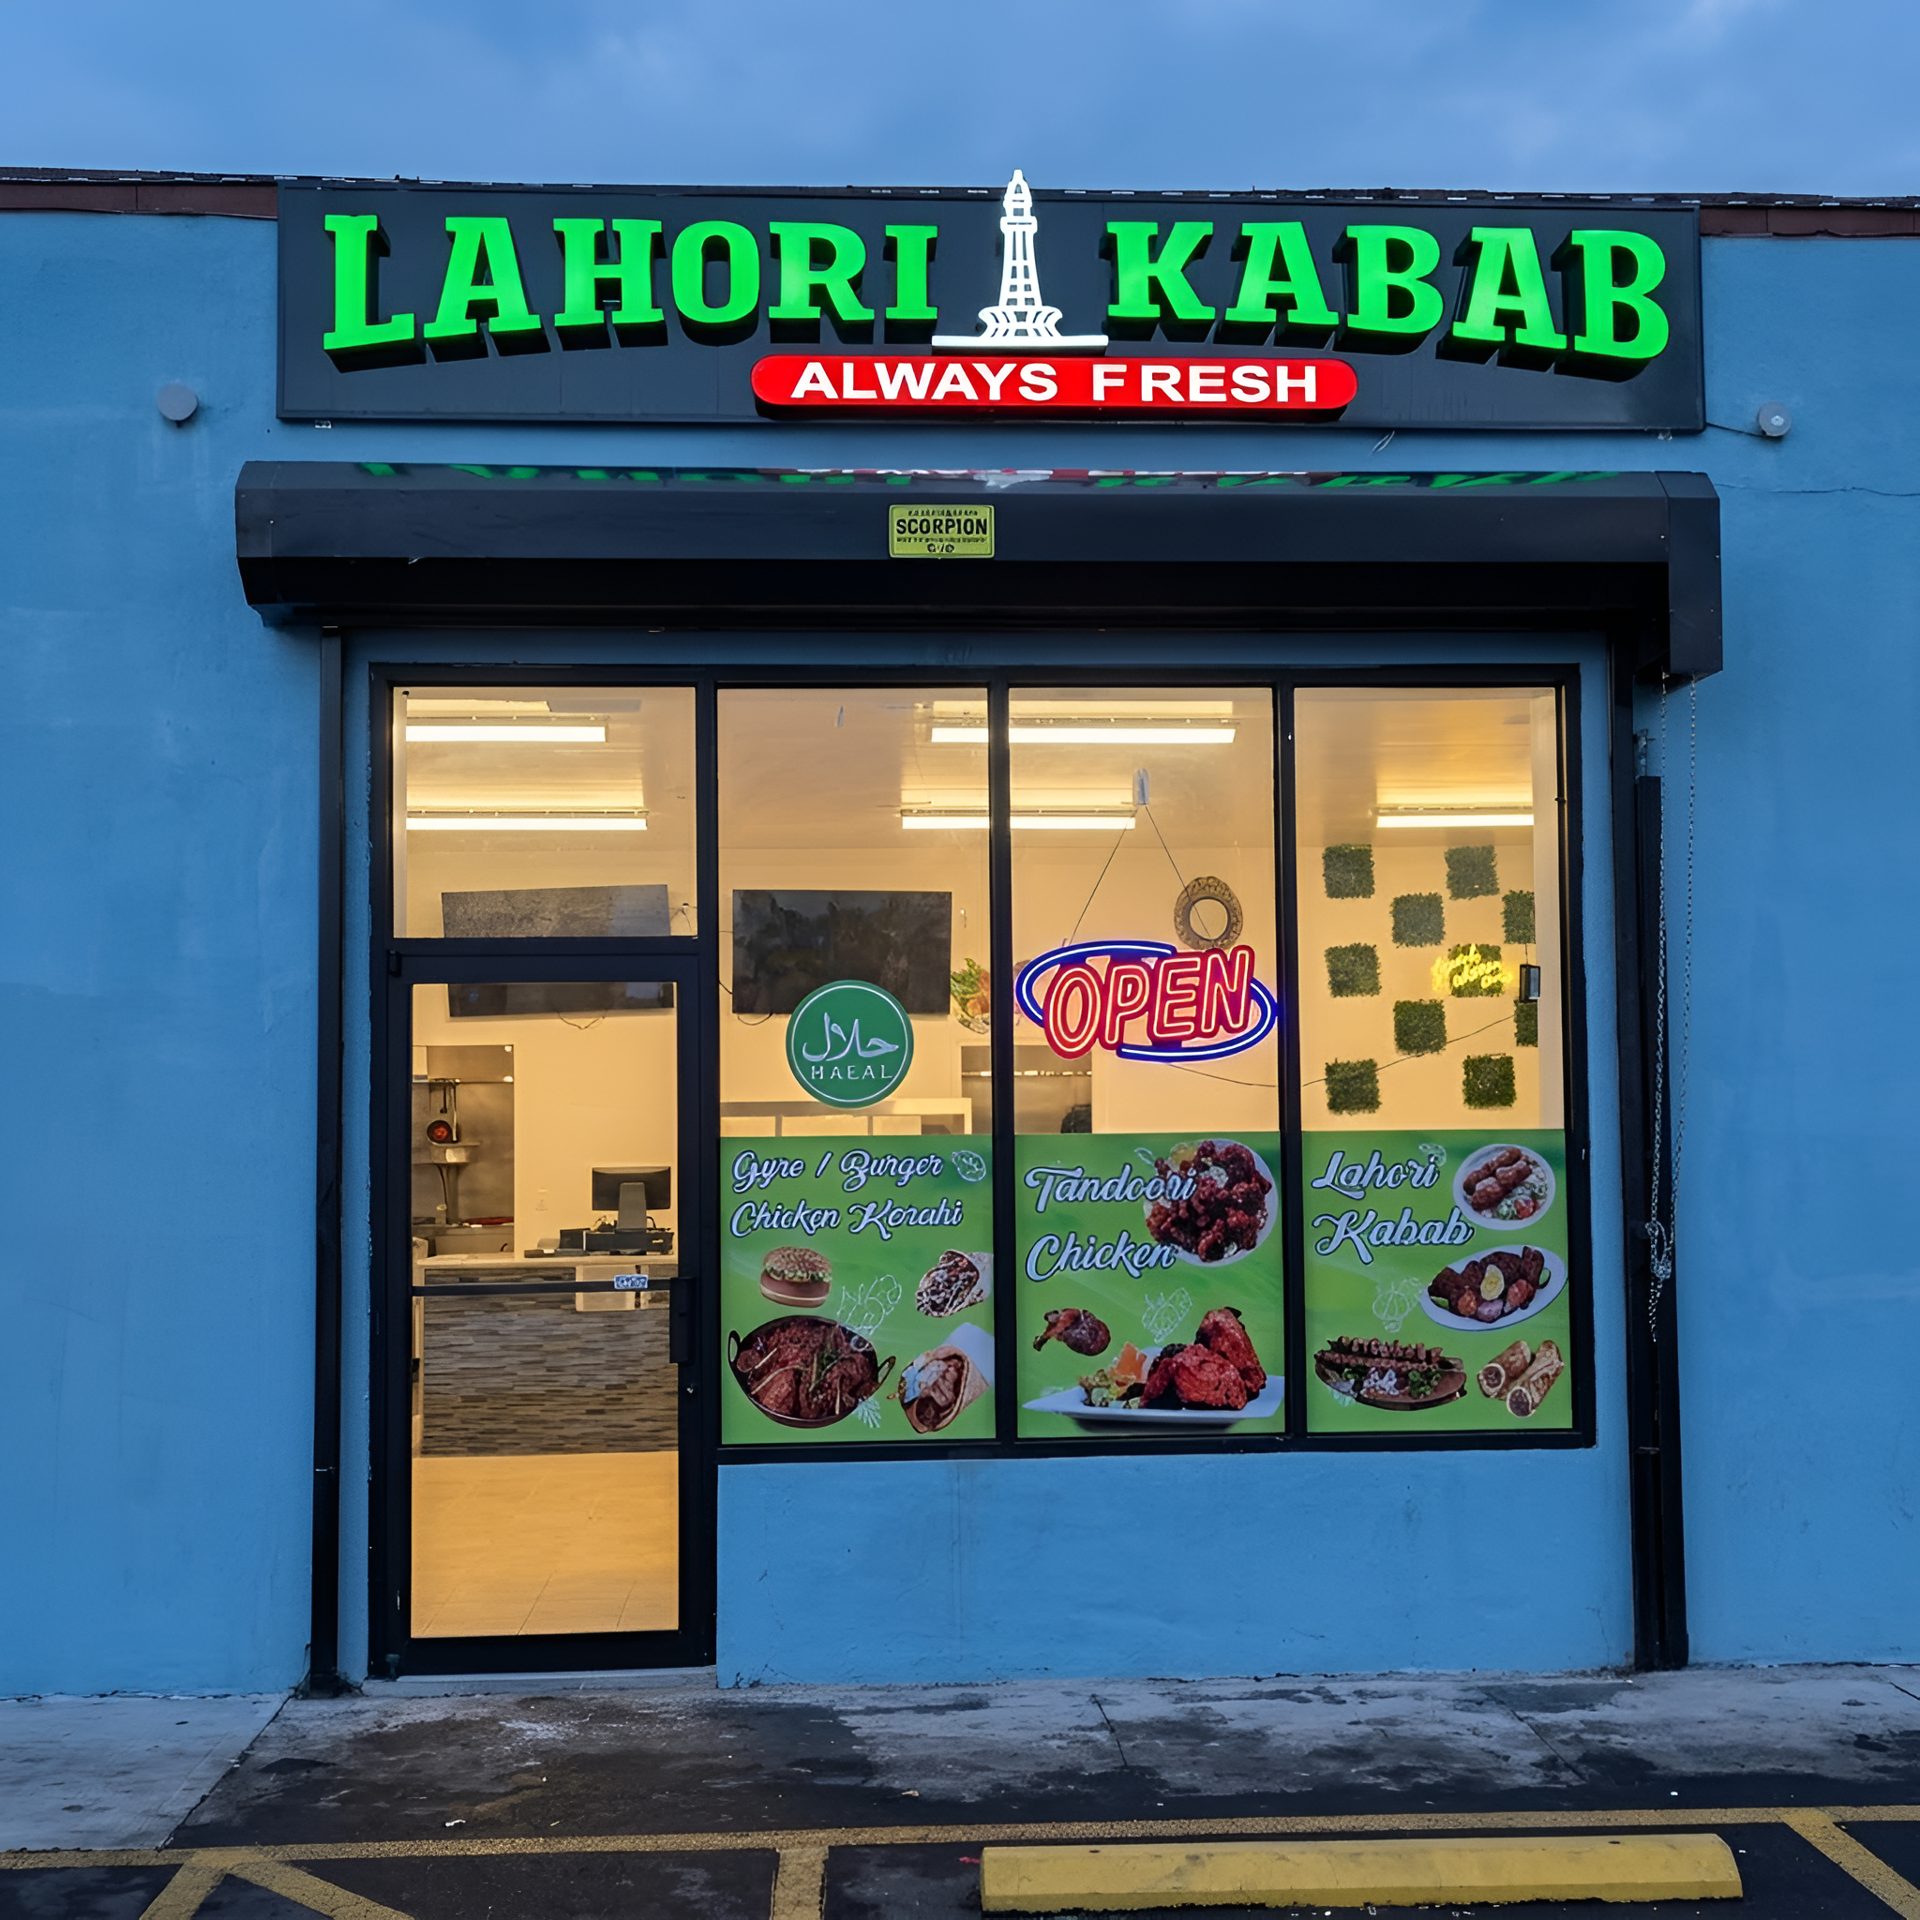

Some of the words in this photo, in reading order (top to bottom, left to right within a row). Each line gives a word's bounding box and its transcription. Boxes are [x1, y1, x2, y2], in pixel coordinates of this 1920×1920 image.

[323, 213, 939, 351] LAHORI
[1106, 220, 1671, 360] KABAB
[790, 361, 1058, 402] ALWAYS
[1092, 363, 1318, 403] FRESH
[895, 518, 988, 536] SCORPION
[1043, 944, 1256, 1060] OPEN
[802, 1011, 899, 1062] حلال
[839, 1149, 944, 1193] Burger
[1024, 1163, 1198, 1213] Tandoori
[1311, 1150, 1440, 1200] Lahori
[730, 1199, 841, 1238] Chicken
[1312, 1206, 1475, 1265] Kabab
[1025, 1229, 1176, 1283] Chicken
